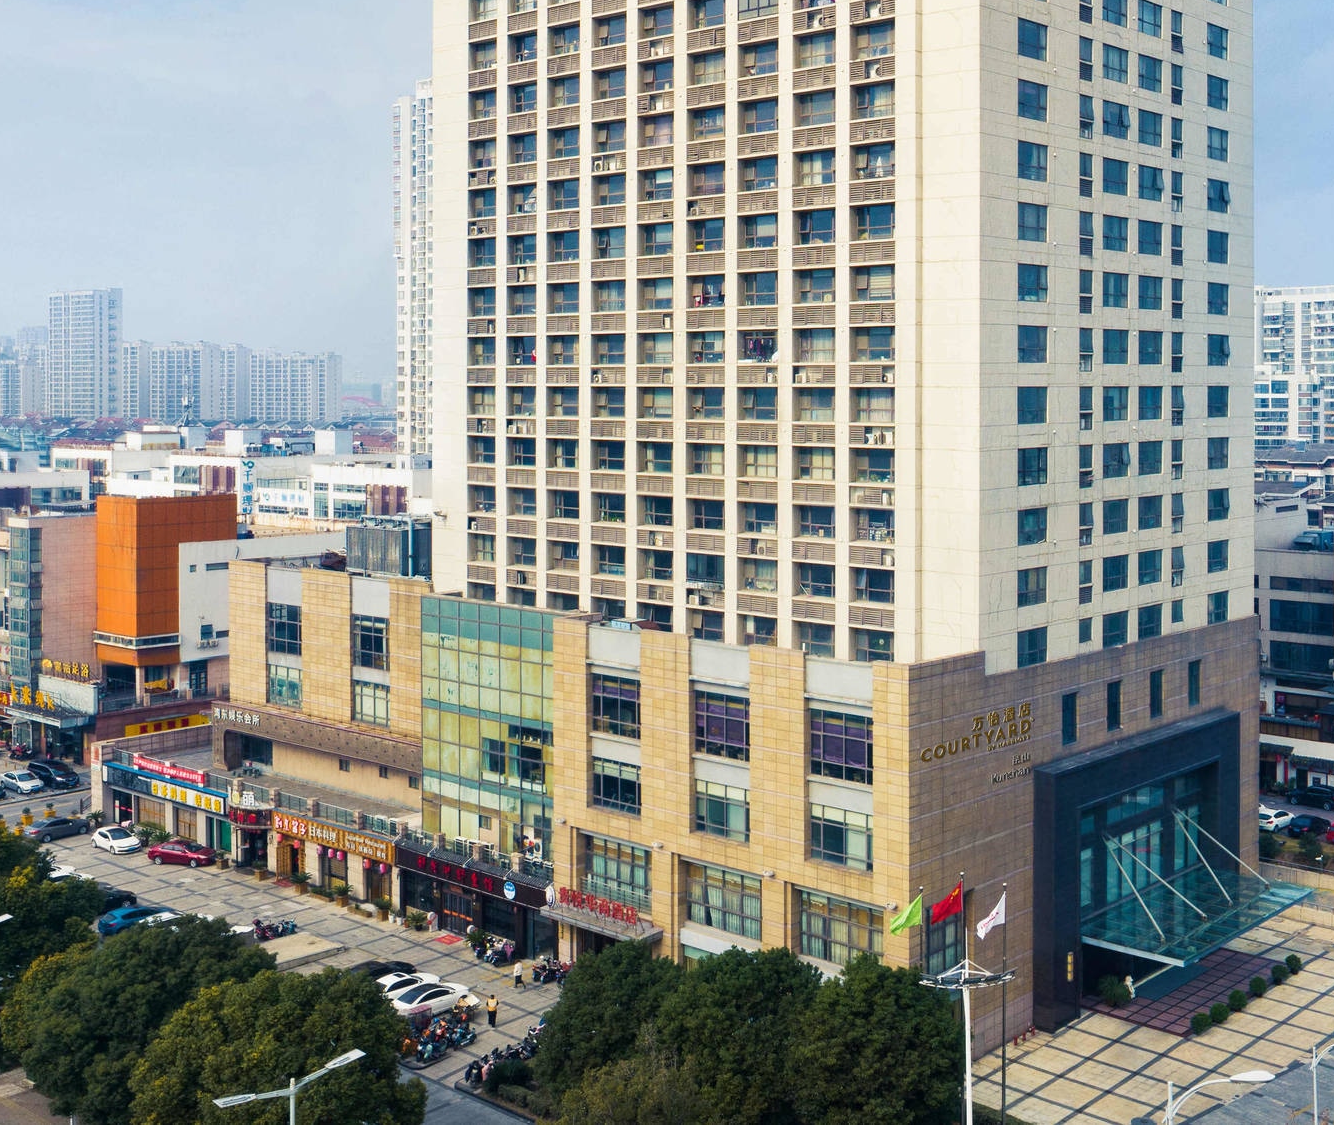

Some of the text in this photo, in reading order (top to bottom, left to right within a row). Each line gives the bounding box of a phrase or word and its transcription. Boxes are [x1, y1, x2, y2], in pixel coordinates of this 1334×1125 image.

[971, 702, 1031, 732] 万怡酒店
[921, 719, 1031, 763] COURTYARD
[1012, 752, 1031, 766] 昆山
